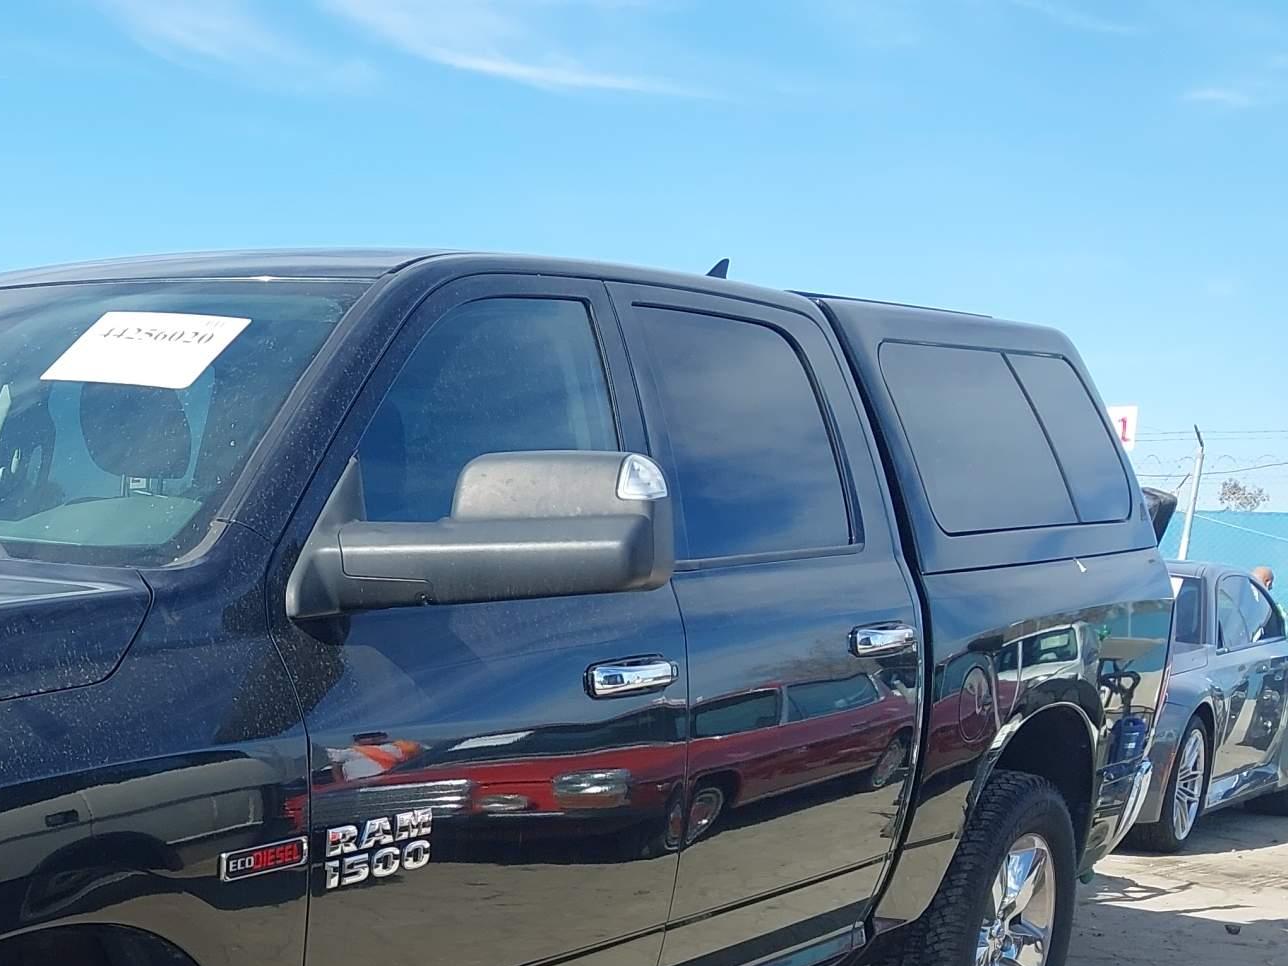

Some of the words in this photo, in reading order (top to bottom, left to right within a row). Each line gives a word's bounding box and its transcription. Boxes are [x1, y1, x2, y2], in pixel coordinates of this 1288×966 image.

[101, 327, 214, 344] 44256020
[325, 807, 434, 857] RAM
[228, 842, 302, 873] ECODIESEL
[324, 840, 432, 889] 1500
